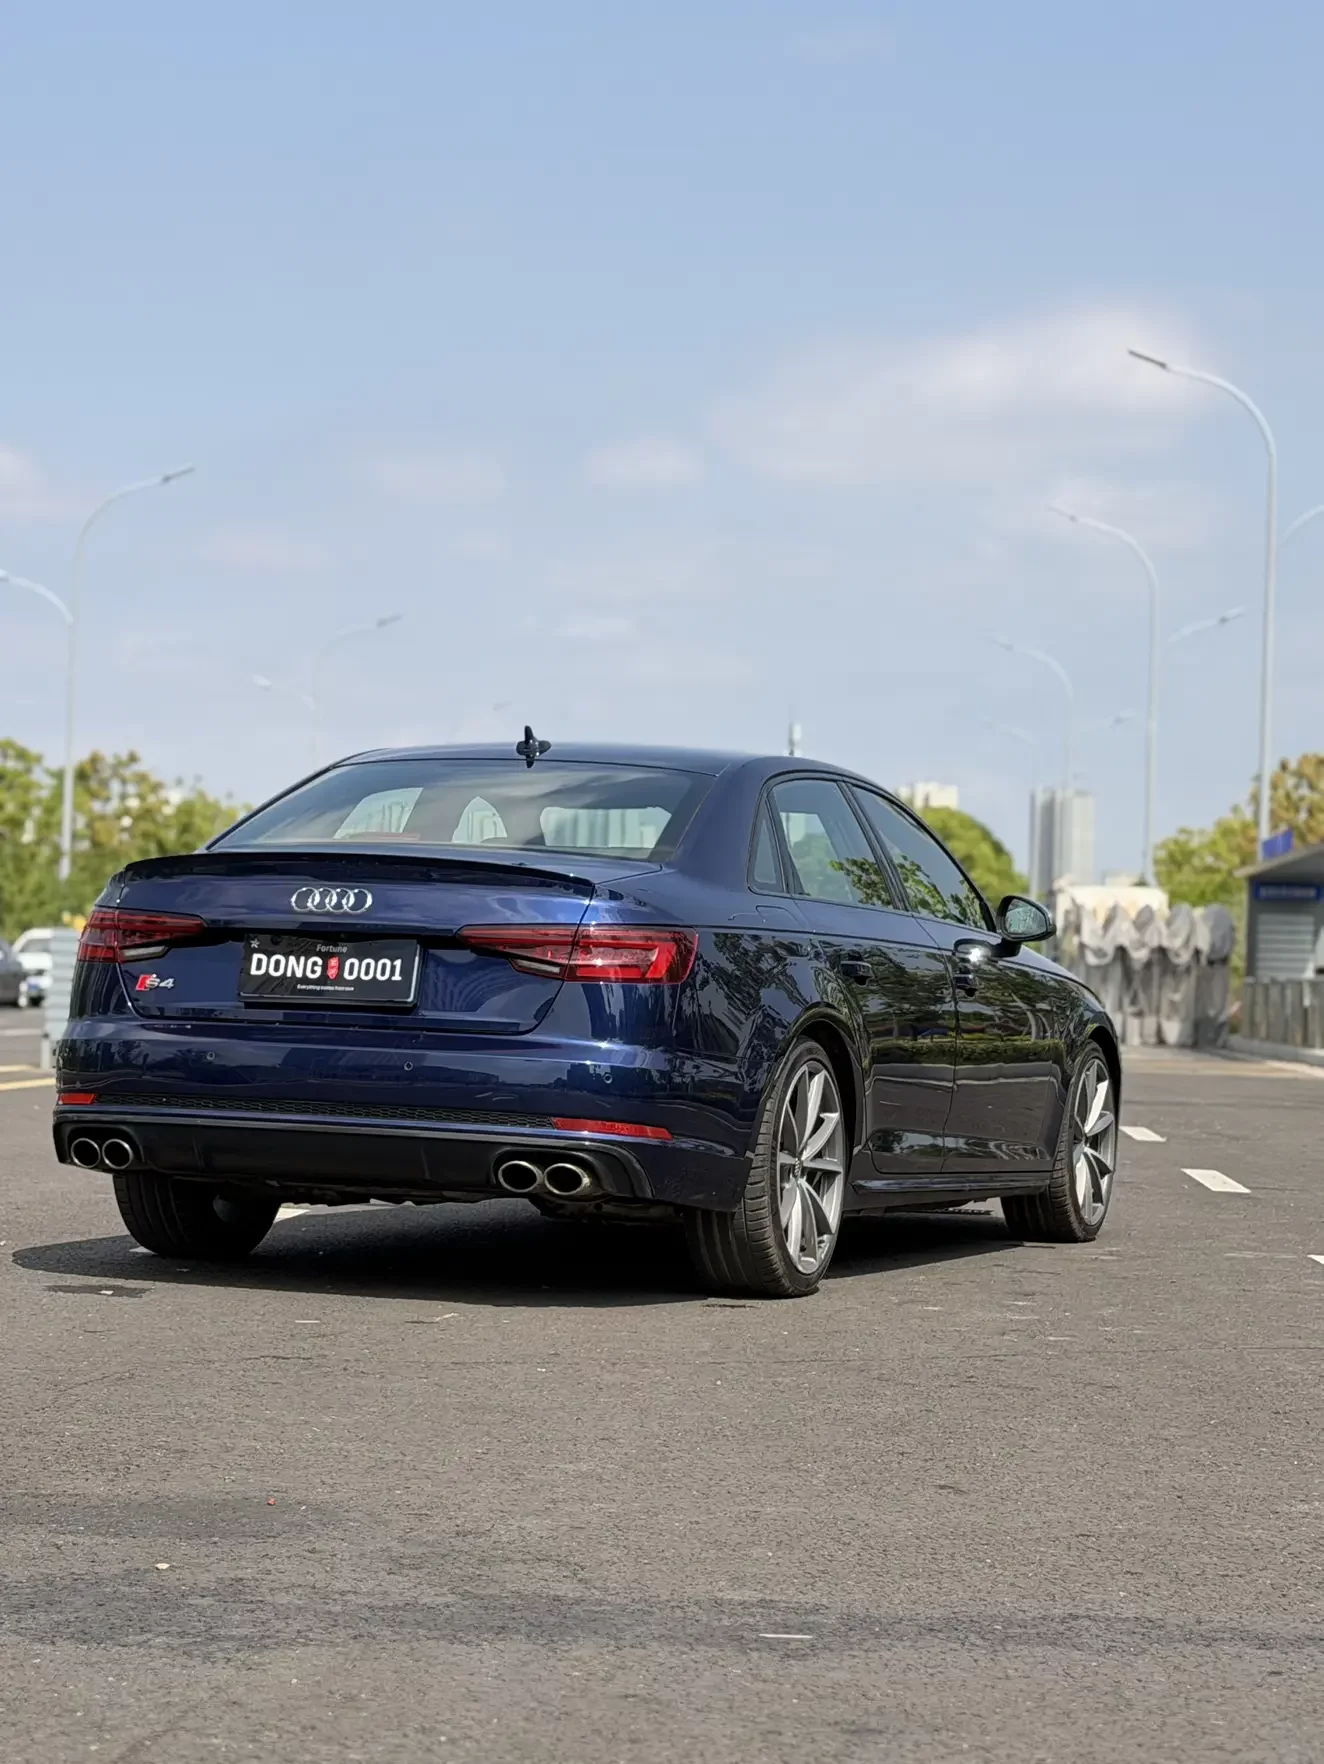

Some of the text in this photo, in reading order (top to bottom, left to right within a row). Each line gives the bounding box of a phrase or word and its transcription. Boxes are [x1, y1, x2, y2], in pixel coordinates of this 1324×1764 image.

[316, 944, 348, 953] Fortune
[250, 953, 403, 981] DONG 0001
[143, 974, 175, 989] S4
